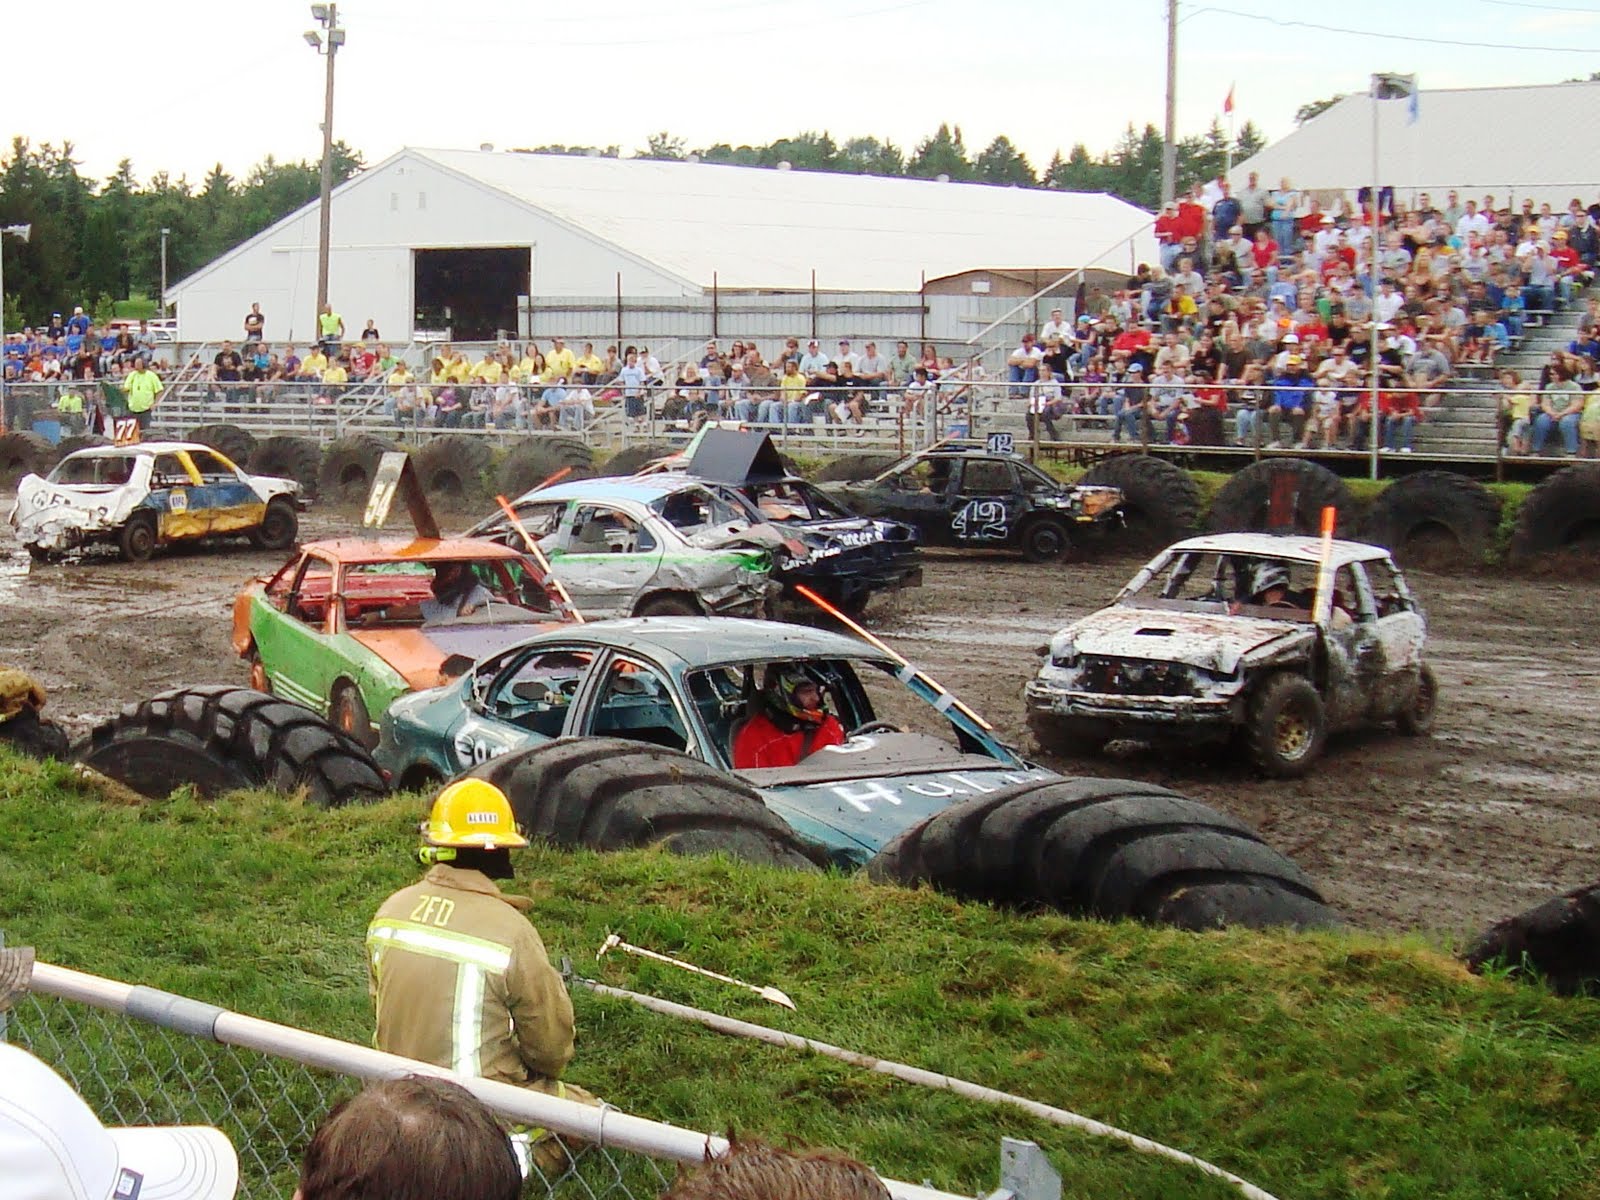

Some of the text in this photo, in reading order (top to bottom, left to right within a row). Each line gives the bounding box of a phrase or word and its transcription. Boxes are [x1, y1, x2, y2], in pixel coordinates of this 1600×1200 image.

[115, 417, 138, 441] 77
[987, 433, 1014, 454] 42
[952, 500, 1009, 539] 42
[409, 894, 455, 927] ZFD
